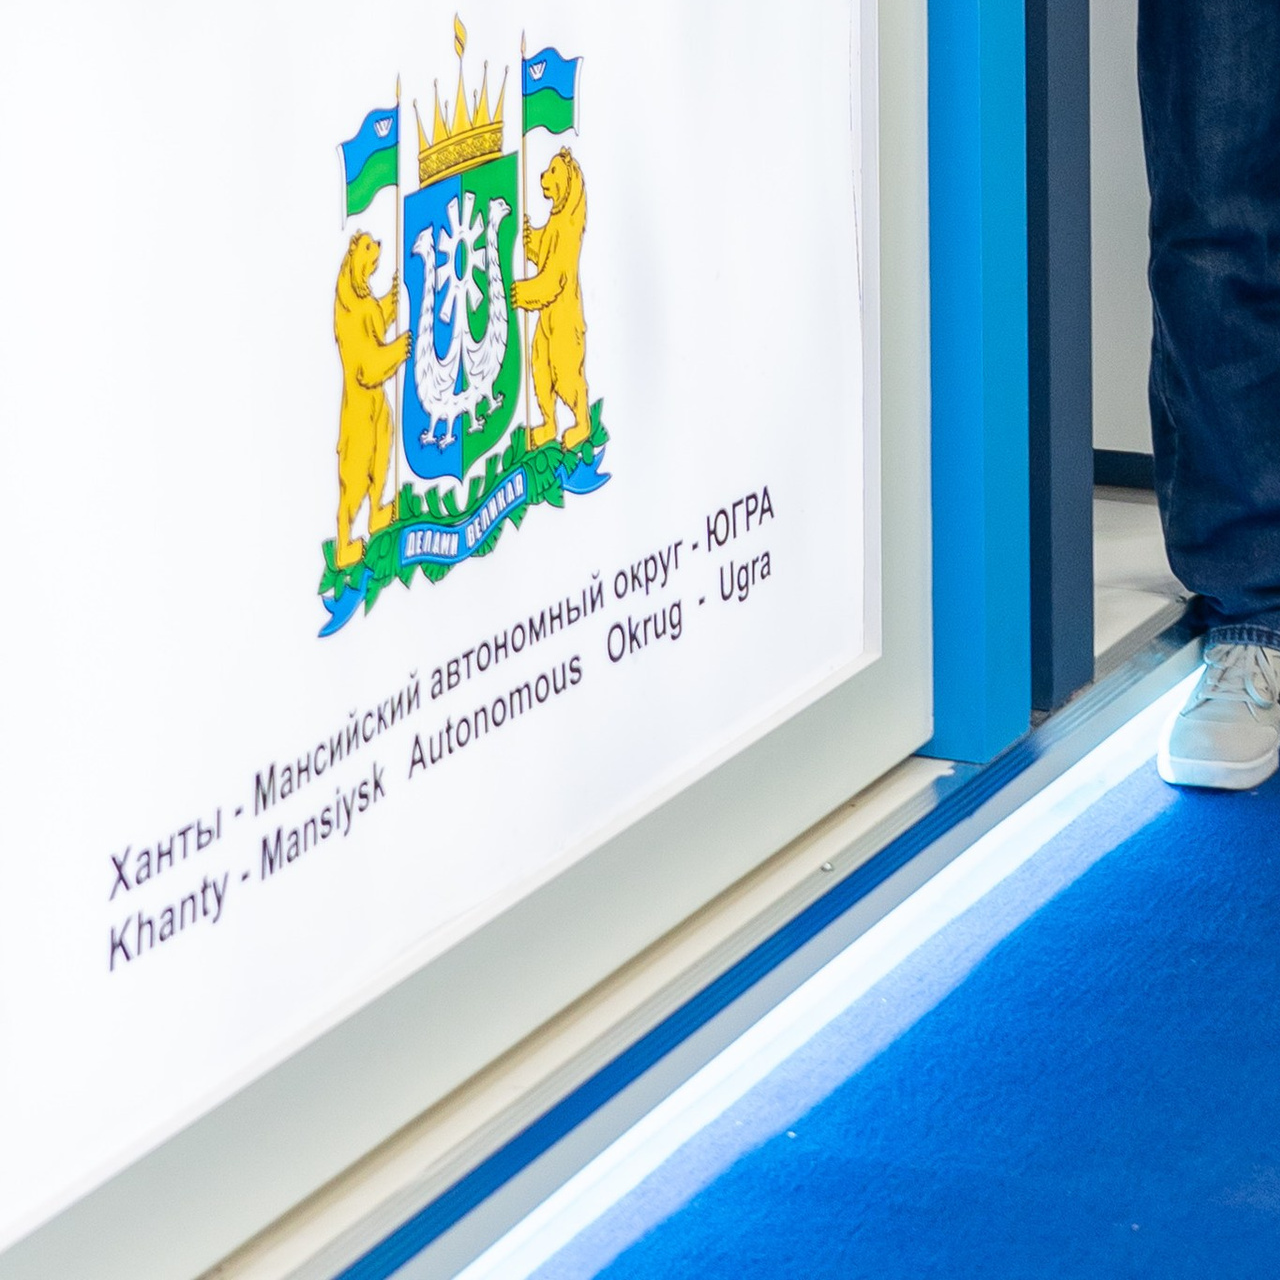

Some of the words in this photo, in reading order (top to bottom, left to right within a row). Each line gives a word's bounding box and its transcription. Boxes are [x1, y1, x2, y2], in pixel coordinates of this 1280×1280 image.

[109, 806, 222, 901] Ханты
[254, 668, 421, 817] Мансийский
[430, 569, 604, 700] автономный
[613, 539, 684, 599] округ
[706, 486, 774, 552] ЮГРА
[406, 529, 459, 558] ДЕЛАМИ
[465, 473, 524, 549] ВЕЛИКАЯ
[109, 870, 229, 972] Khanty
[260, 760, 386, 881] Mansiysk
[408, 654, 583, 780] Autonomous
[606, 598, 683, 663] Okrug
[719, 549, 772, 603] Ugra
